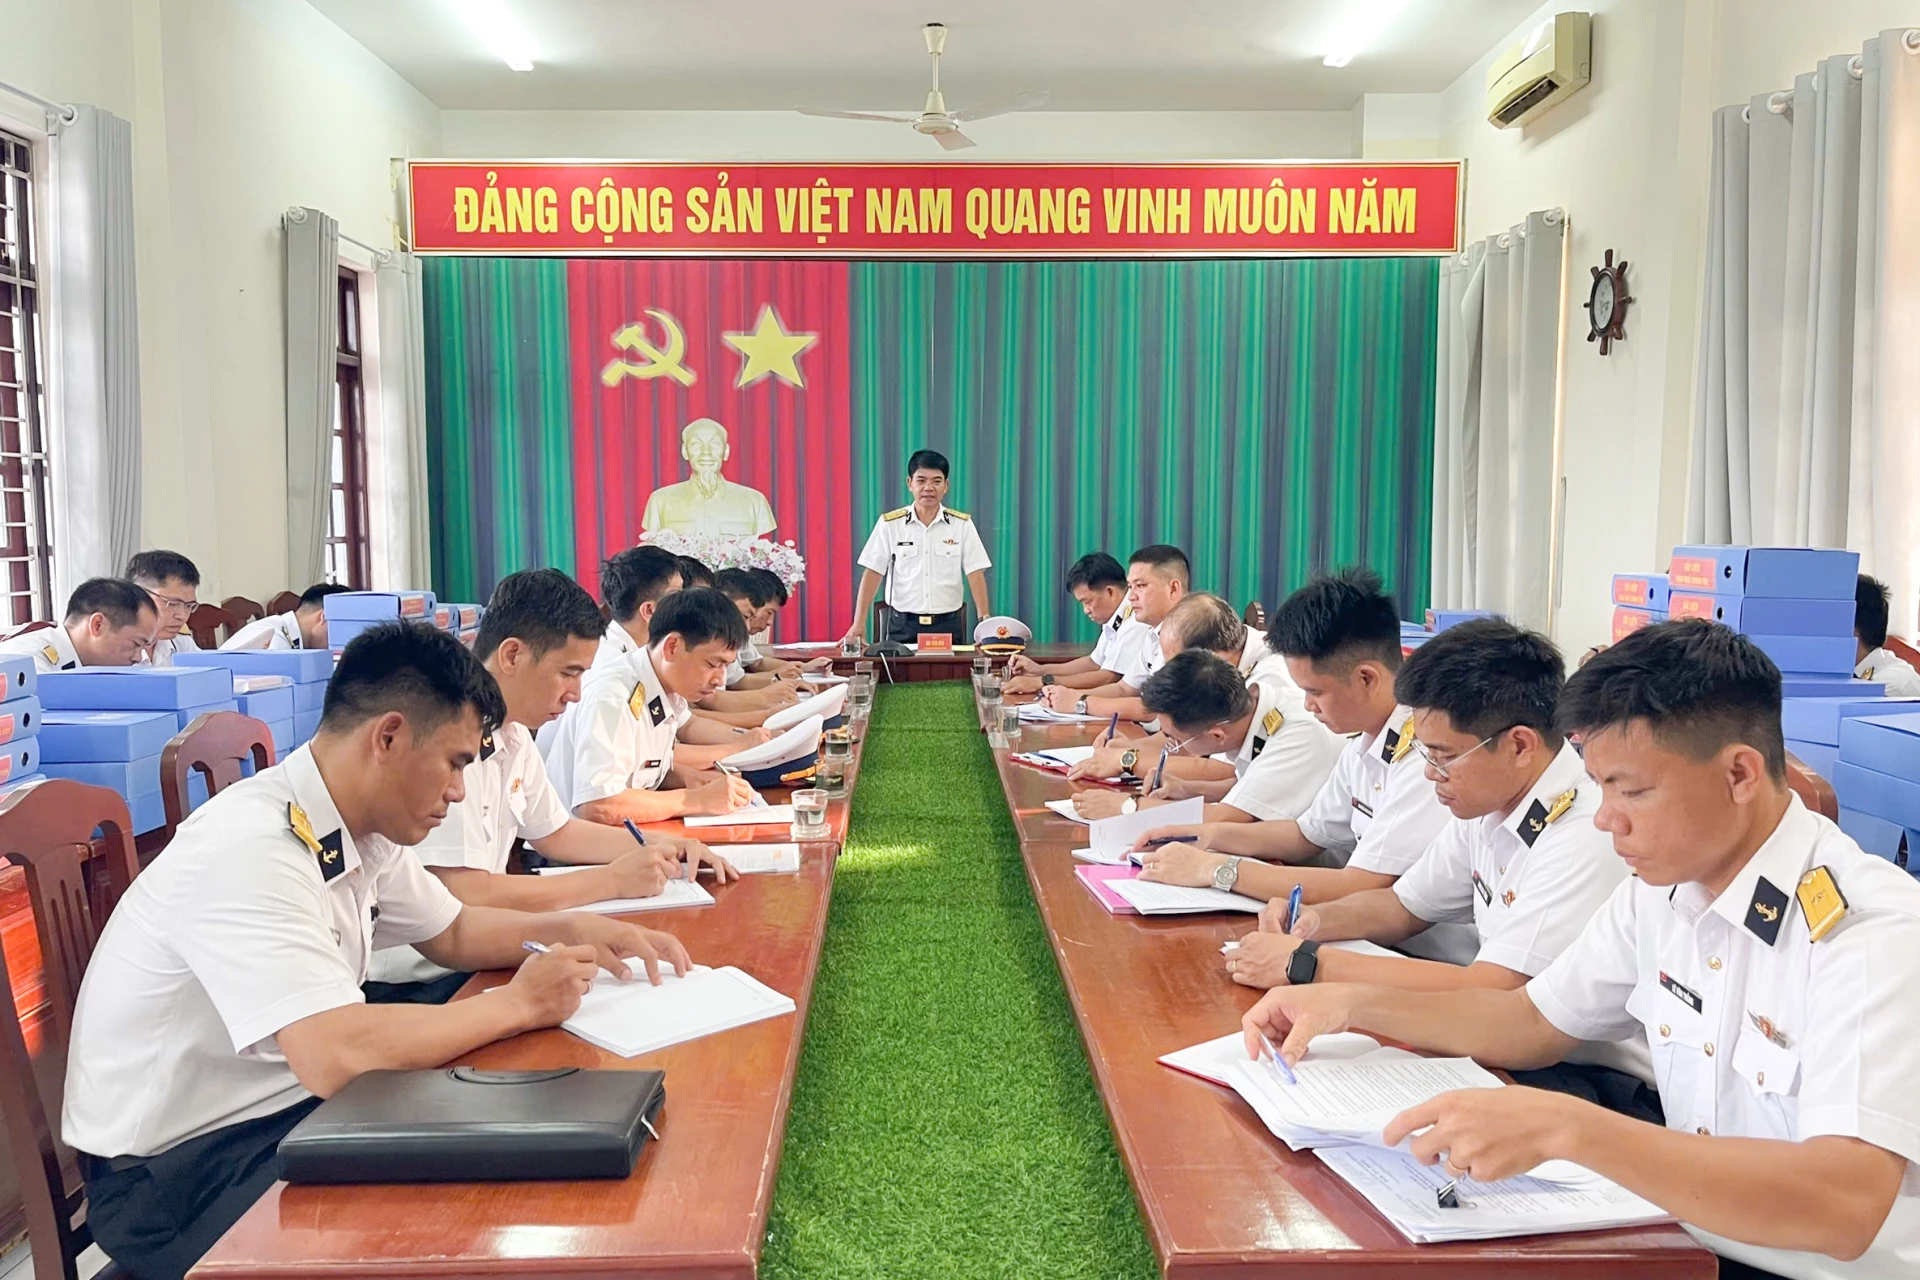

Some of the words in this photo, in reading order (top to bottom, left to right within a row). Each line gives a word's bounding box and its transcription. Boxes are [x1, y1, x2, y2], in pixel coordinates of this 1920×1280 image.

[454, 172, 558, 233] ĐẢNG
[571, 177, 673, 243] CỘNG
[686, 172, 763, 233] SẢN
[774, 178, 853, 243] VIỆT
[866, 188, 952, 233] NAM
[965, 188, 1091, 239] QUANG
[1103, 188, 1191, 233] VINH
[1203, 178, 1316, 234] MUÔN
[1328, 178, 1417, 233] NĂM
